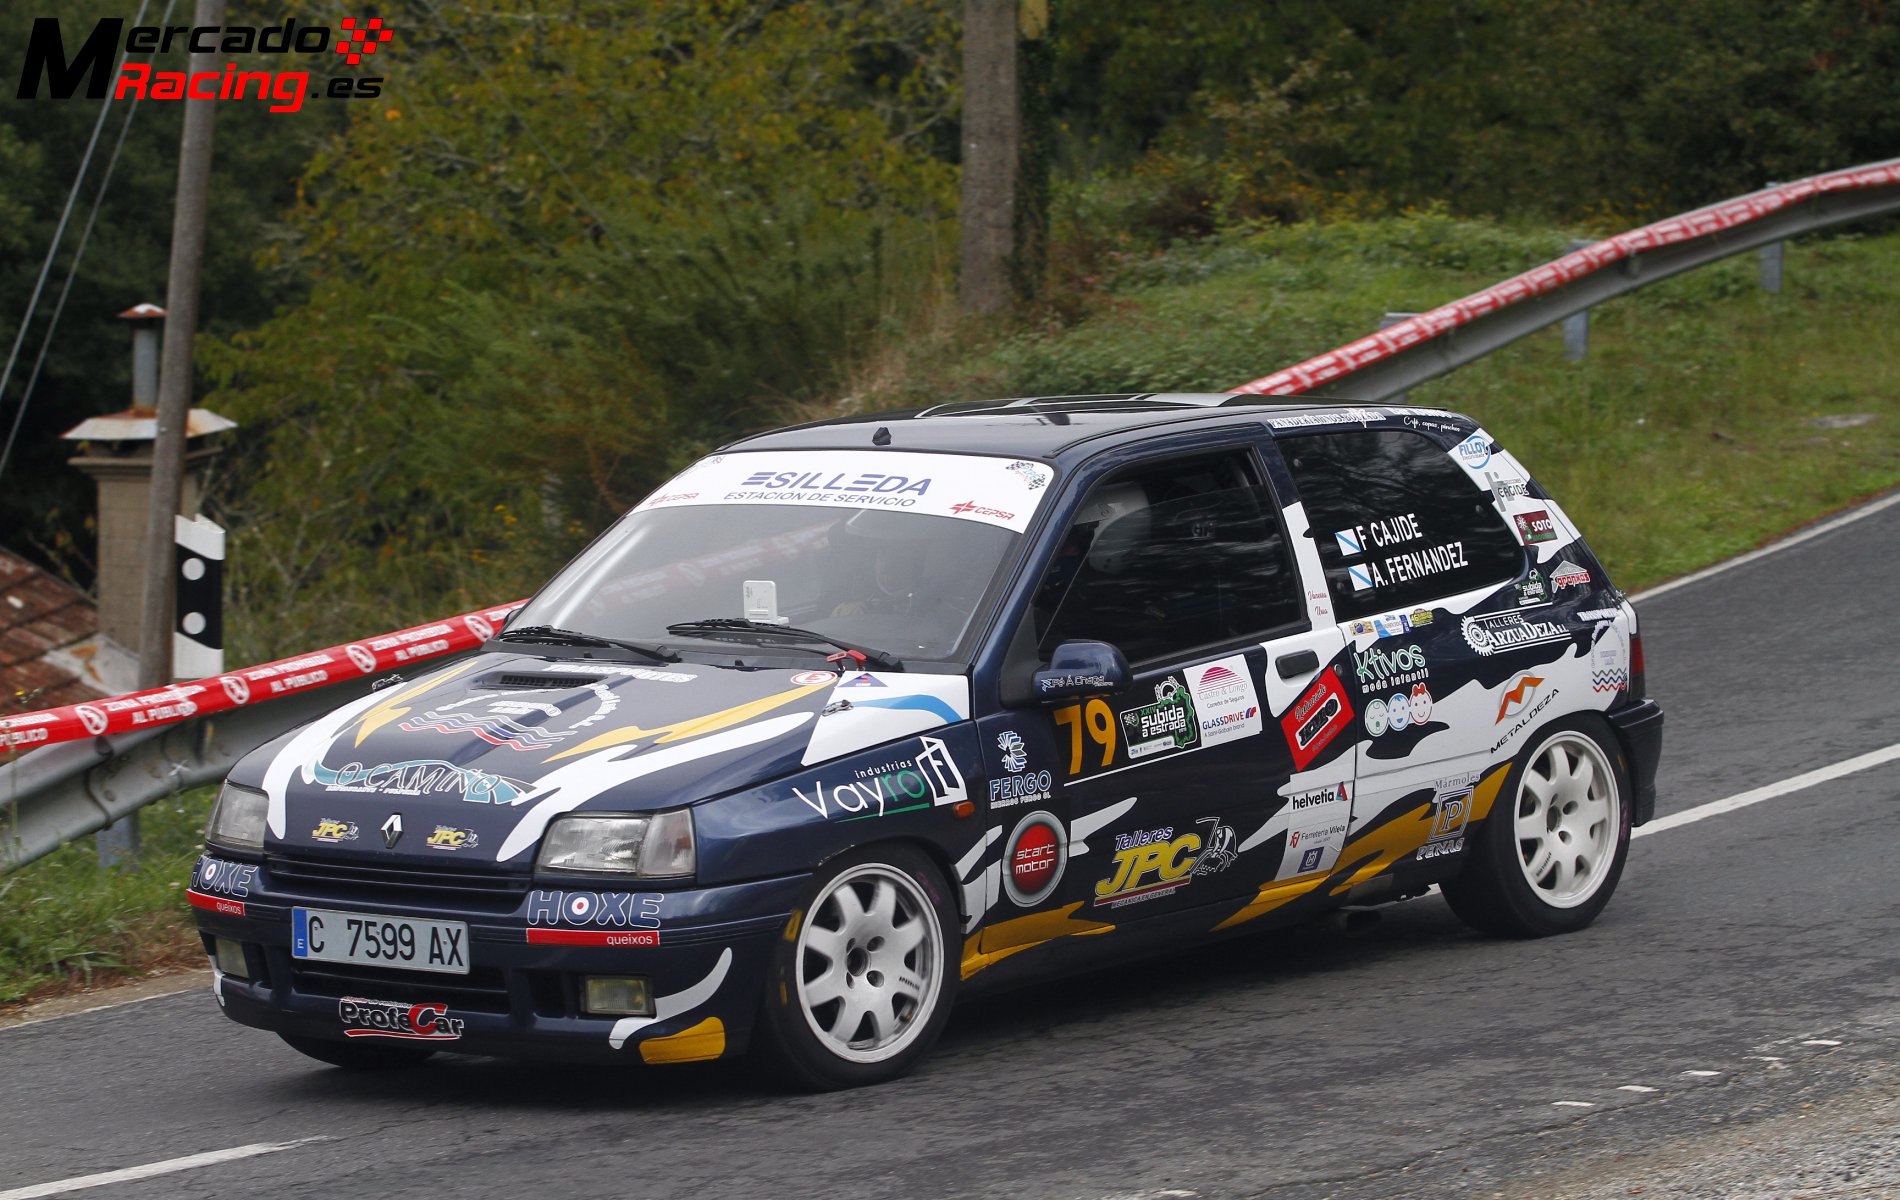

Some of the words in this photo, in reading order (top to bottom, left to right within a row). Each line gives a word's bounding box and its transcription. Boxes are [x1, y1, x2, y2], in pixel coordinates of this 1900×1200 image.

[1459, 441, 1486, 456] FILLOY
[723, 490, 805, 502] ESTACIÓN
[807, 493, 832, 502] DE
[833, 494, 917, 508] SERVICIO
[974, 505, 1016, 521] CEPSA
[1356, 525, 1367, 551] F
[1370, 513, 1423, 548] CAJIDE
[1531, 518, 1553, 532] SOTO
[1372, 561, 1389, 588] A.
[1385, 541, 1469, 584] FERNANDEZ
[1484, 614, 1525, 630] TALLERES
[1353, 644, 1426, 684] Ktivos
[1362, 678, 1388, 694] moda
[1391, 668, 1430, 687] infantil
[1199, 690, 1220, 702] Castro
[1221, 687, 1228, 696] &
[1228, 682, 1248, 694] Longo
[1229, 694, 1245, 704] Seguros
[1141, 705, 1157, 716] XXIV
[1141, 704, 1185, 729] subida
[1202, 711, 1245, 730] GLASSDRIVE
[1149, 717, 1187, 736] estrada
[1233, 722, 1245, 731] brand
[1489, 688, 1560, 754] METALDEZA
[1053, 698, 1117, 776] 79
[854, 758, 914, 779] industrias
[988, 769, 1053, 801] FERGO
[1434, 772, 1481, 792] Mármoles
[1291, 788, 1335, 811] helvetia
[1441, 801, 1463, 831] P
[312, 821, 349, 838] JPC
[426, 829, 466, 845] JPC
[1115, 826, 1174, 850] Talleres
[1016, 843, 1055, 861] start
[1015, 856, 1055, 875] motor
[1094, 833, 1202, 896] JPC
[216, 901, 243, 916] queixos
[526, 889, 665, 928] HOXE
[297, 939, 305, 949] E
[308, 916, 325, 953] C
[346, 919, 416, 961] 7599
[428, 927, 465, 967] AX
[606, 934, 654, 947] queixos
